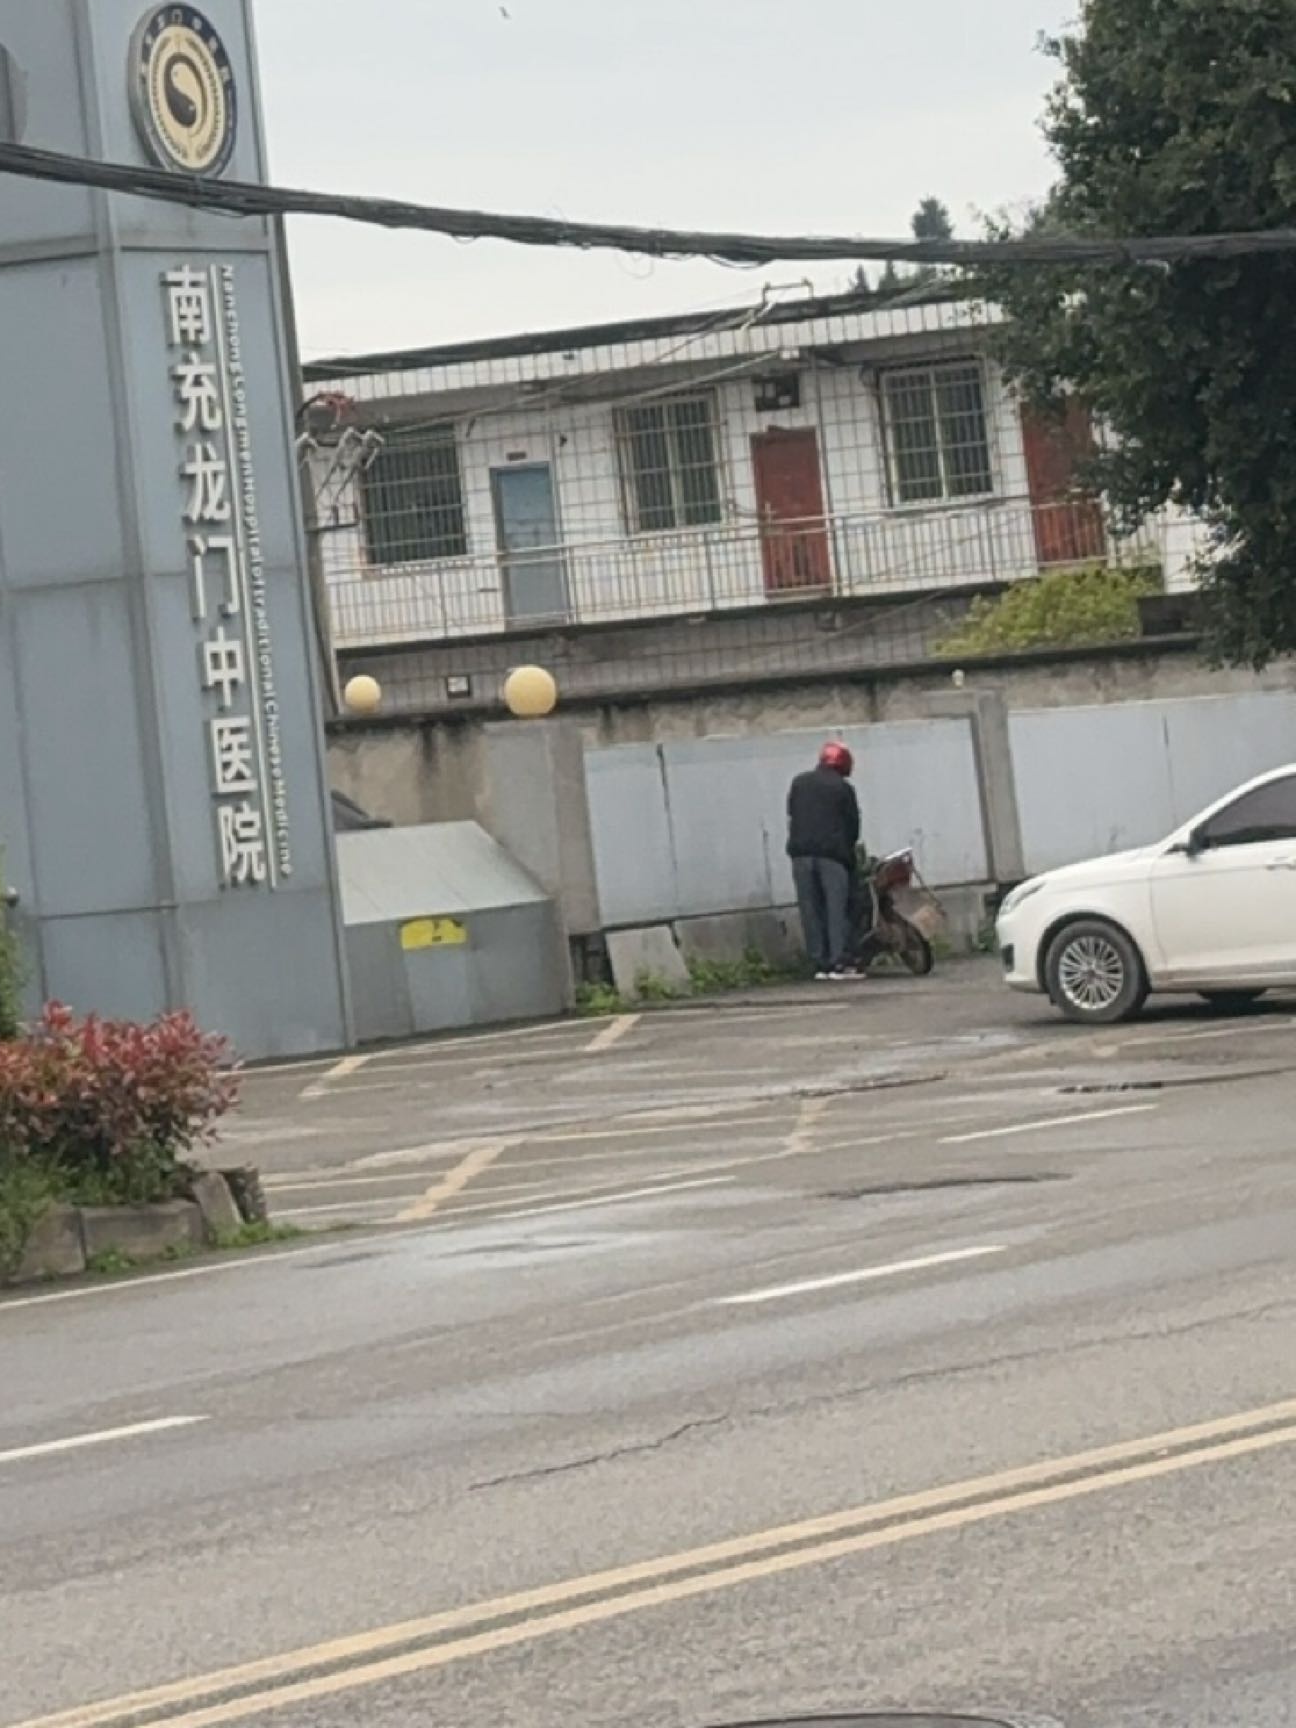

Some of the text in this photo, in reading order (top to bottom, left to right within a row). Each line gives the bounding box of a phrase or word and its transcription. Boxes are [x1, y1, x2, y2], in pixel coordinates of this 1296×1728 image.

[164, 263, 267, 884] 南充龙门中医院
